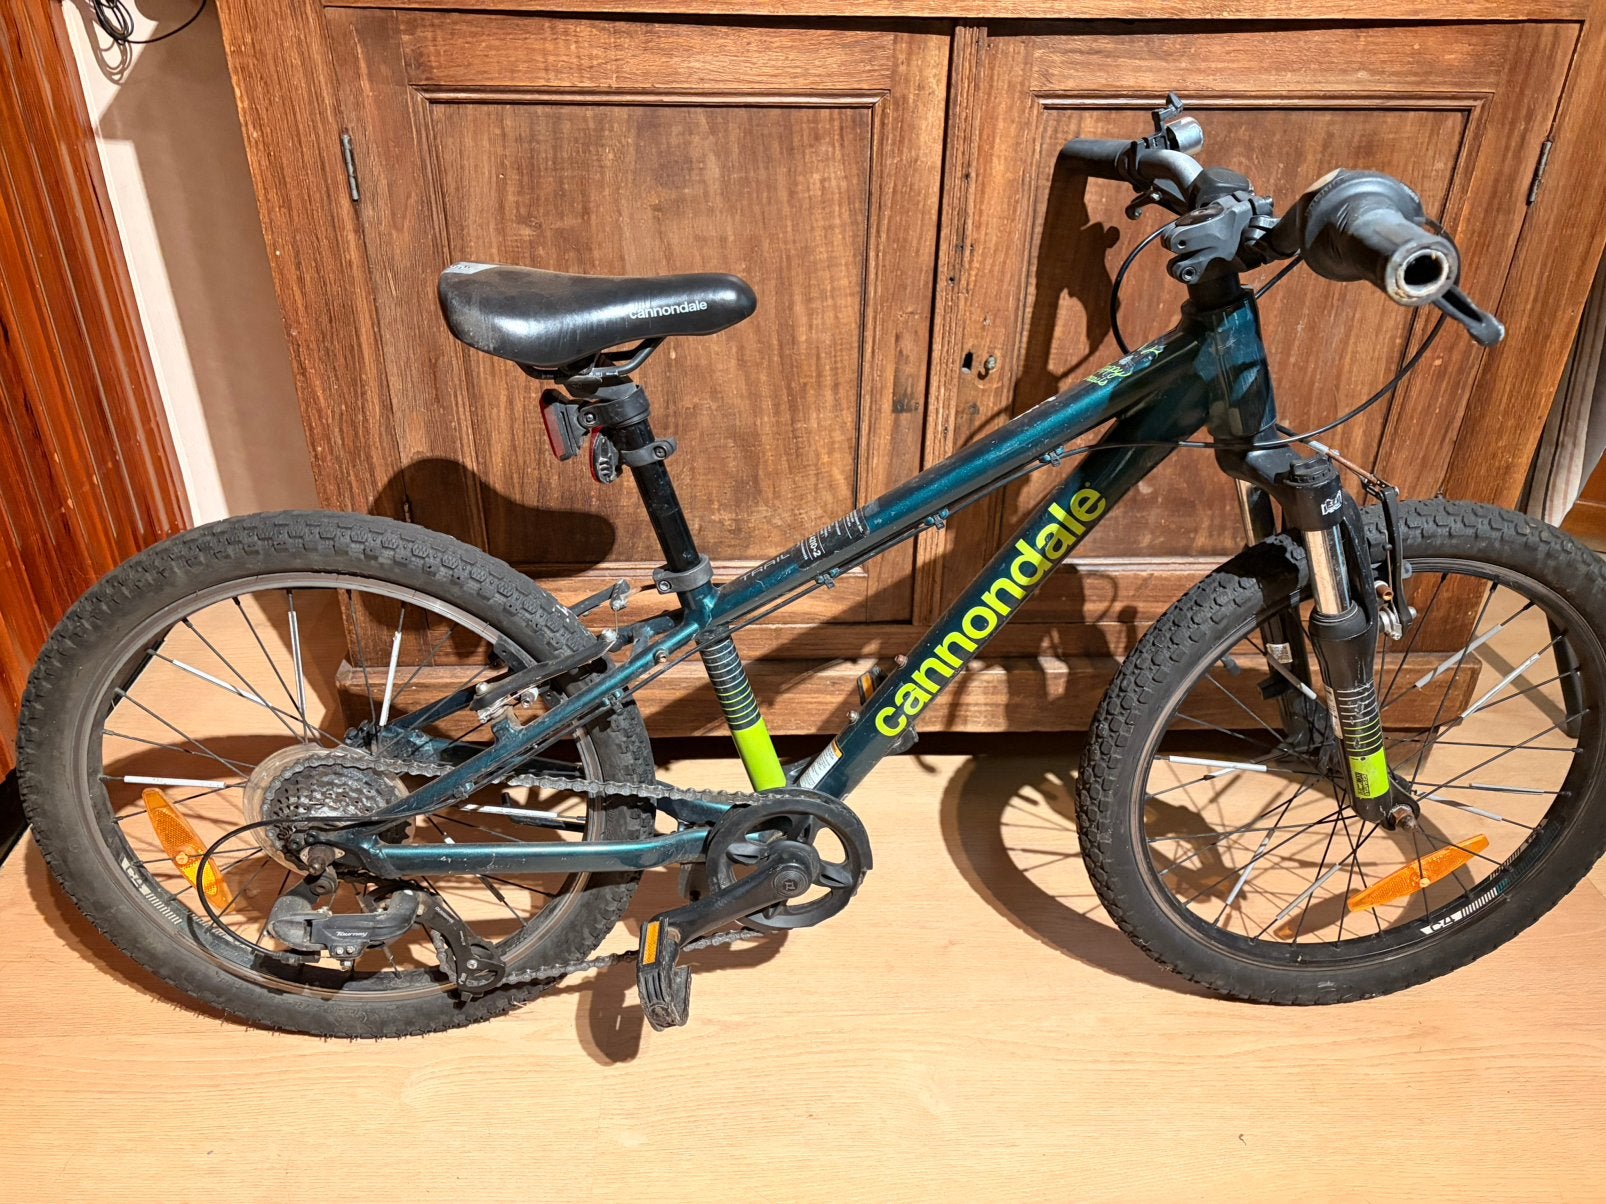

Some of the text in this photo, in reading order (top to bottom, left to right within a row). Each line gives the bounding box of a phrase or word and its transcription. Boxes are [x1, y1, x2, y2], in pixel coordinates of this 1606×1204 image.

[629, 300, 707, 319] cannondale
[875, 487, 1107, 737] cannondale
[335, 930, 369, 938] Tourney
